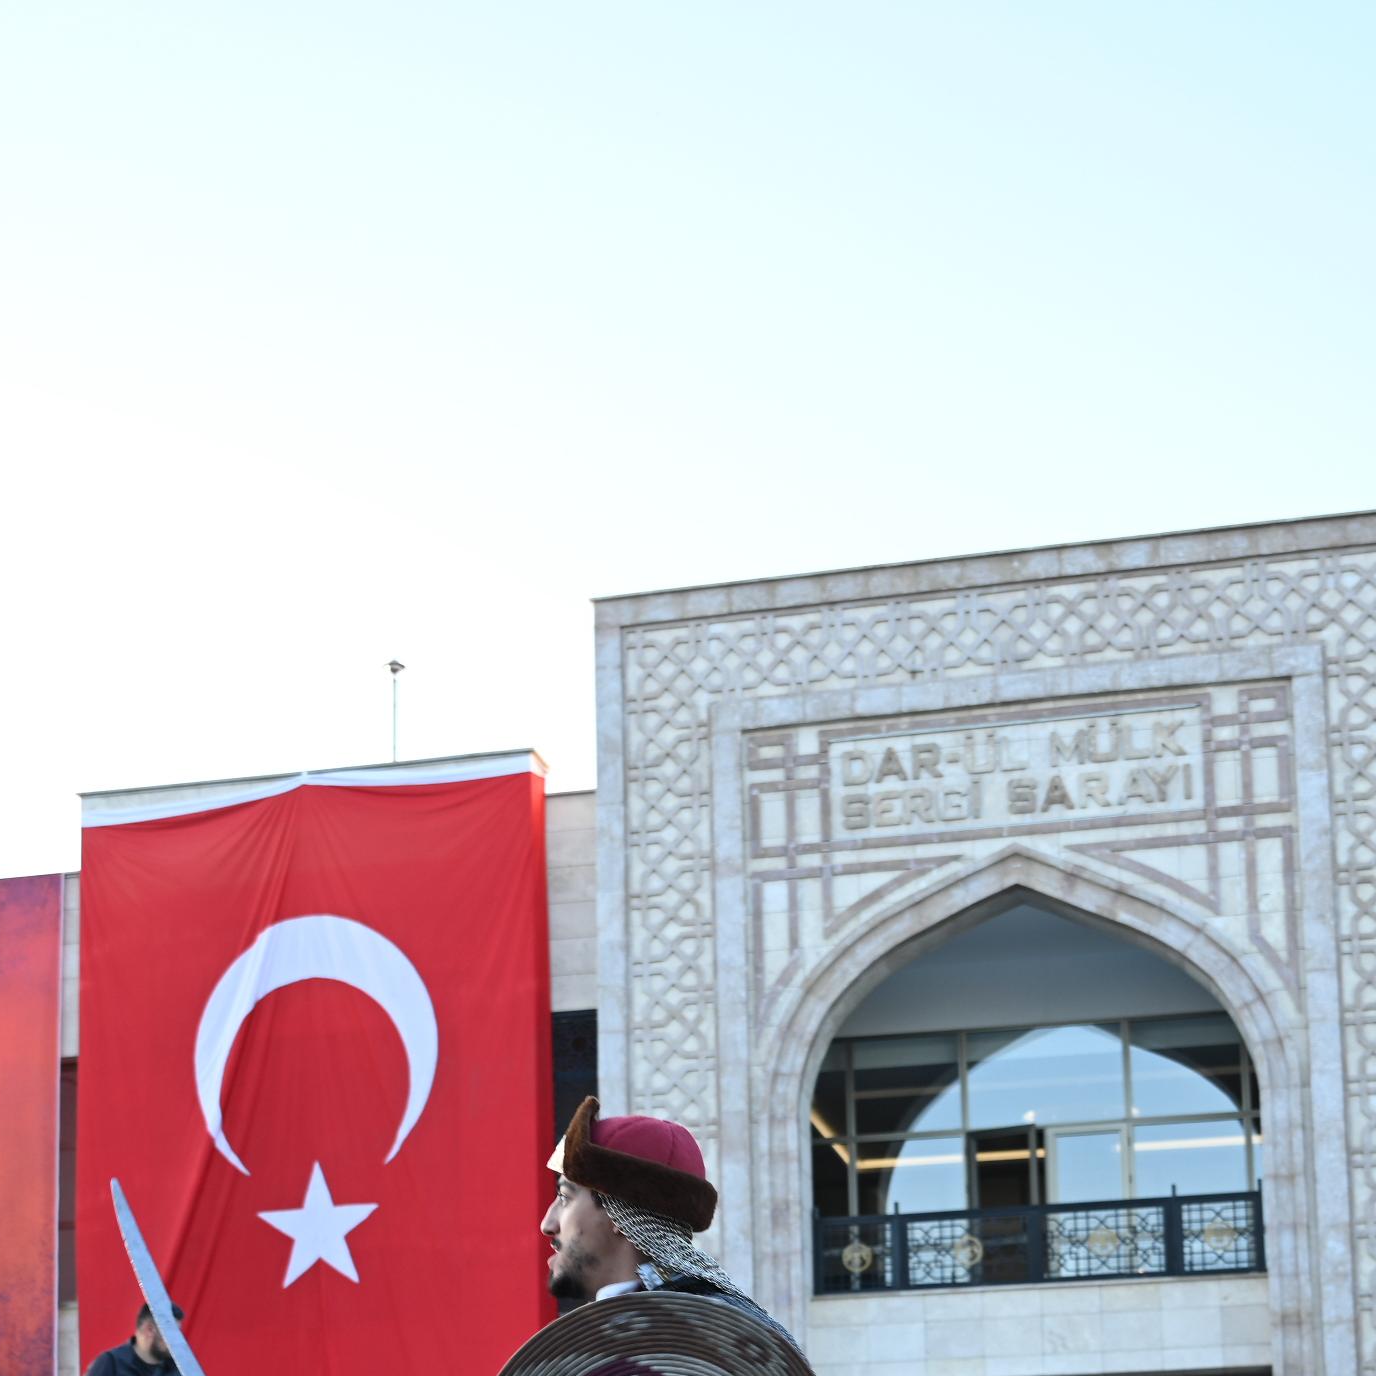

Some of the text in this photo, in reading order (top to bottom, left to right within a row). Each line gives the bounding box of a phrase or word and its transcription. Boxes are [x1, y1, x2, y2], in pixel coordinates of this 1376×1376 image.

[842, 719, 1189, 787] DAR-ÜL MÜLK
[842, 763, 1194, 830] SERGİ SARAYI
